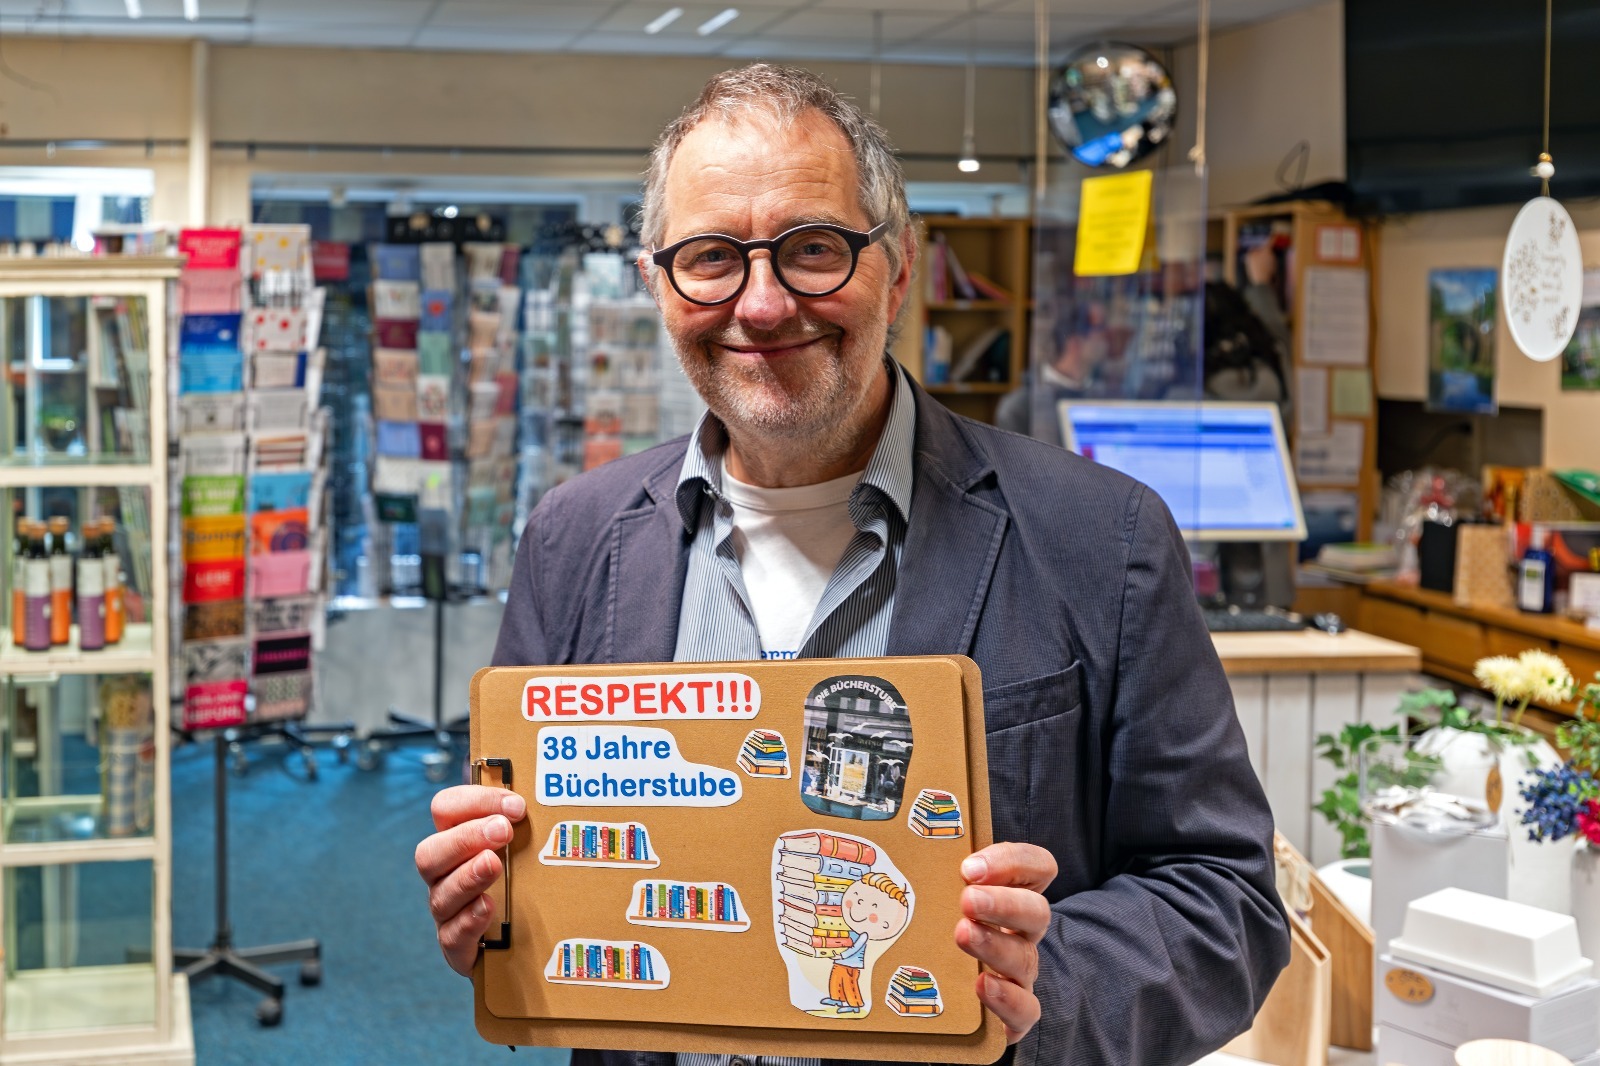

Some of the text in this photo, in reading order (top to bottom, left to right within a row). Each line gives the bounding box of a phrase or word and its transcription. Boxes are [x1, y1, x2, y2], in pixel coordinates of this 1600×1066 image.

[527, 680, 752, 717] RESPEKT!!!
[815, 680, 899, 711] DIE BÜCHERSTUBE
[543, 735, 671, 760] 38 Jahre
[544, 772, 736, 798] Bücherstube
